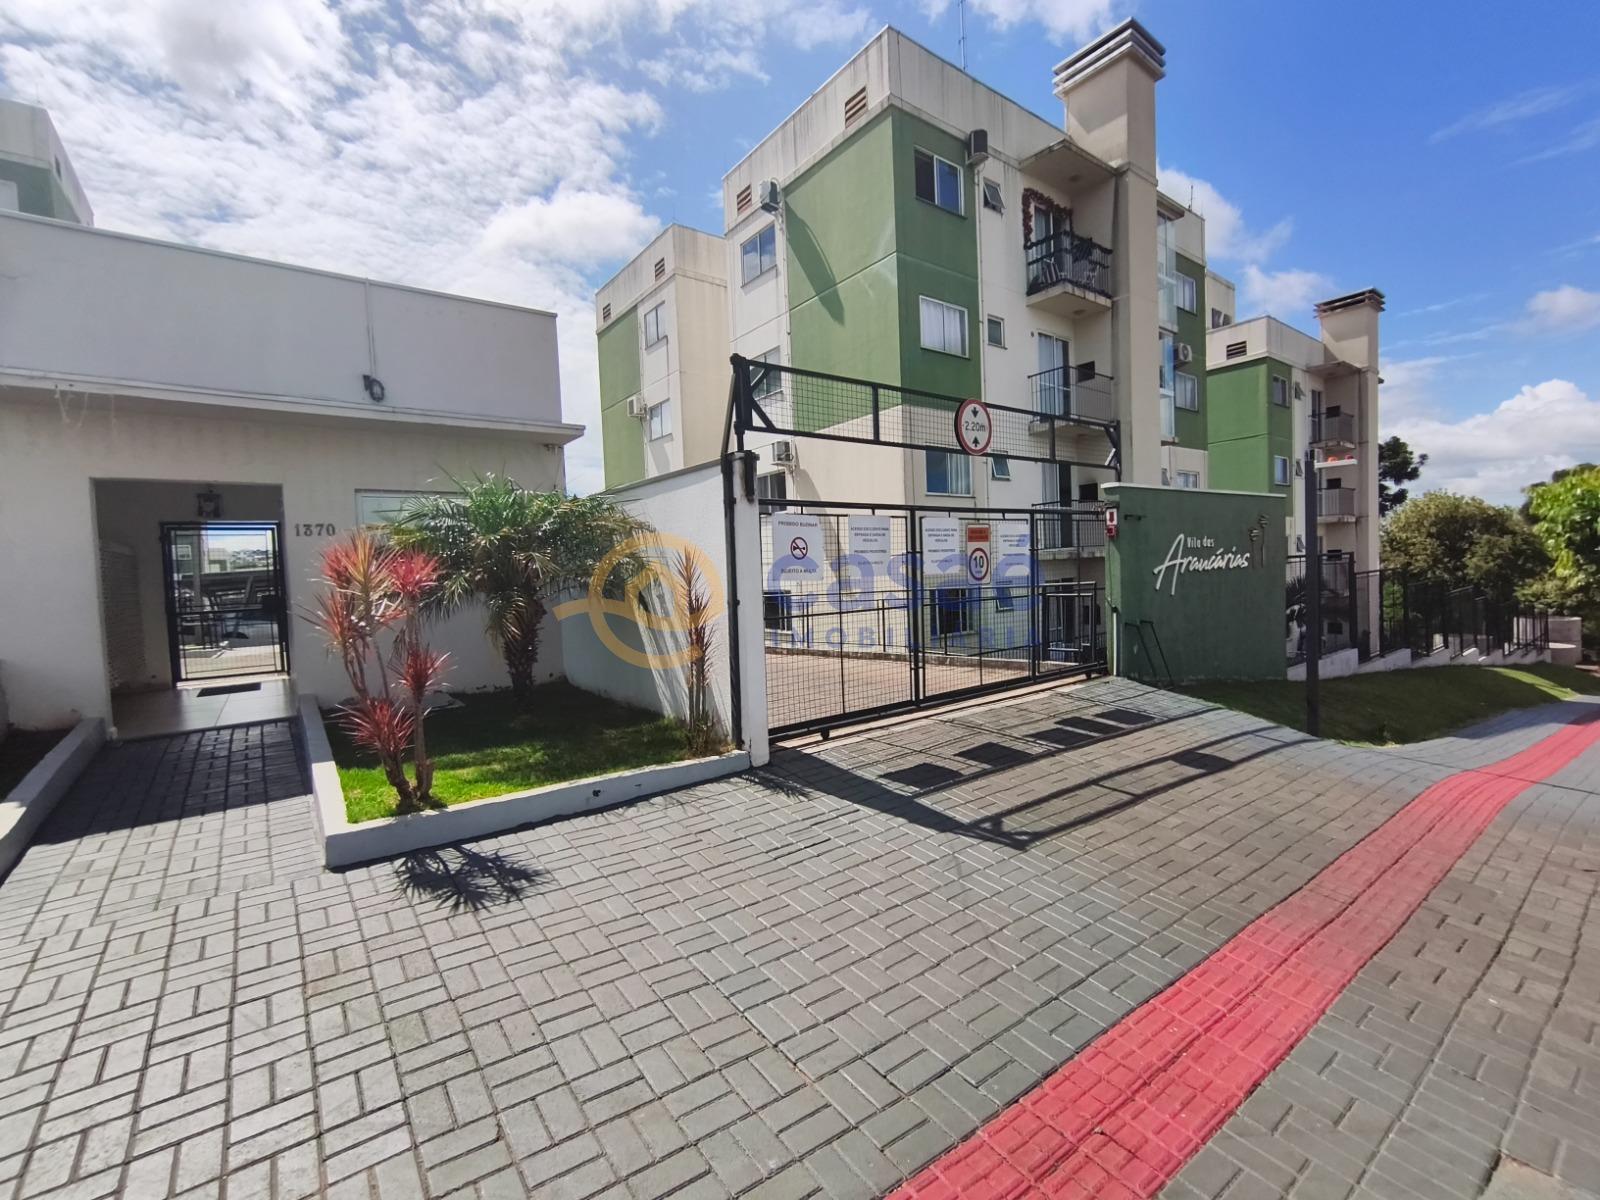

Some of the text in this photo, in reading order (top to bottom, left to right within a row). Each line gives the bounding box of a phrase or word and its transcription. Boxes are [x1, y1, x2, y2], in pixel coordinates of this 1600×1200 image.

[294, 523, 336, 537] 1370
[973, 555, 985, 569] 10
[1152, 533, 1250, 596] Araucárias
